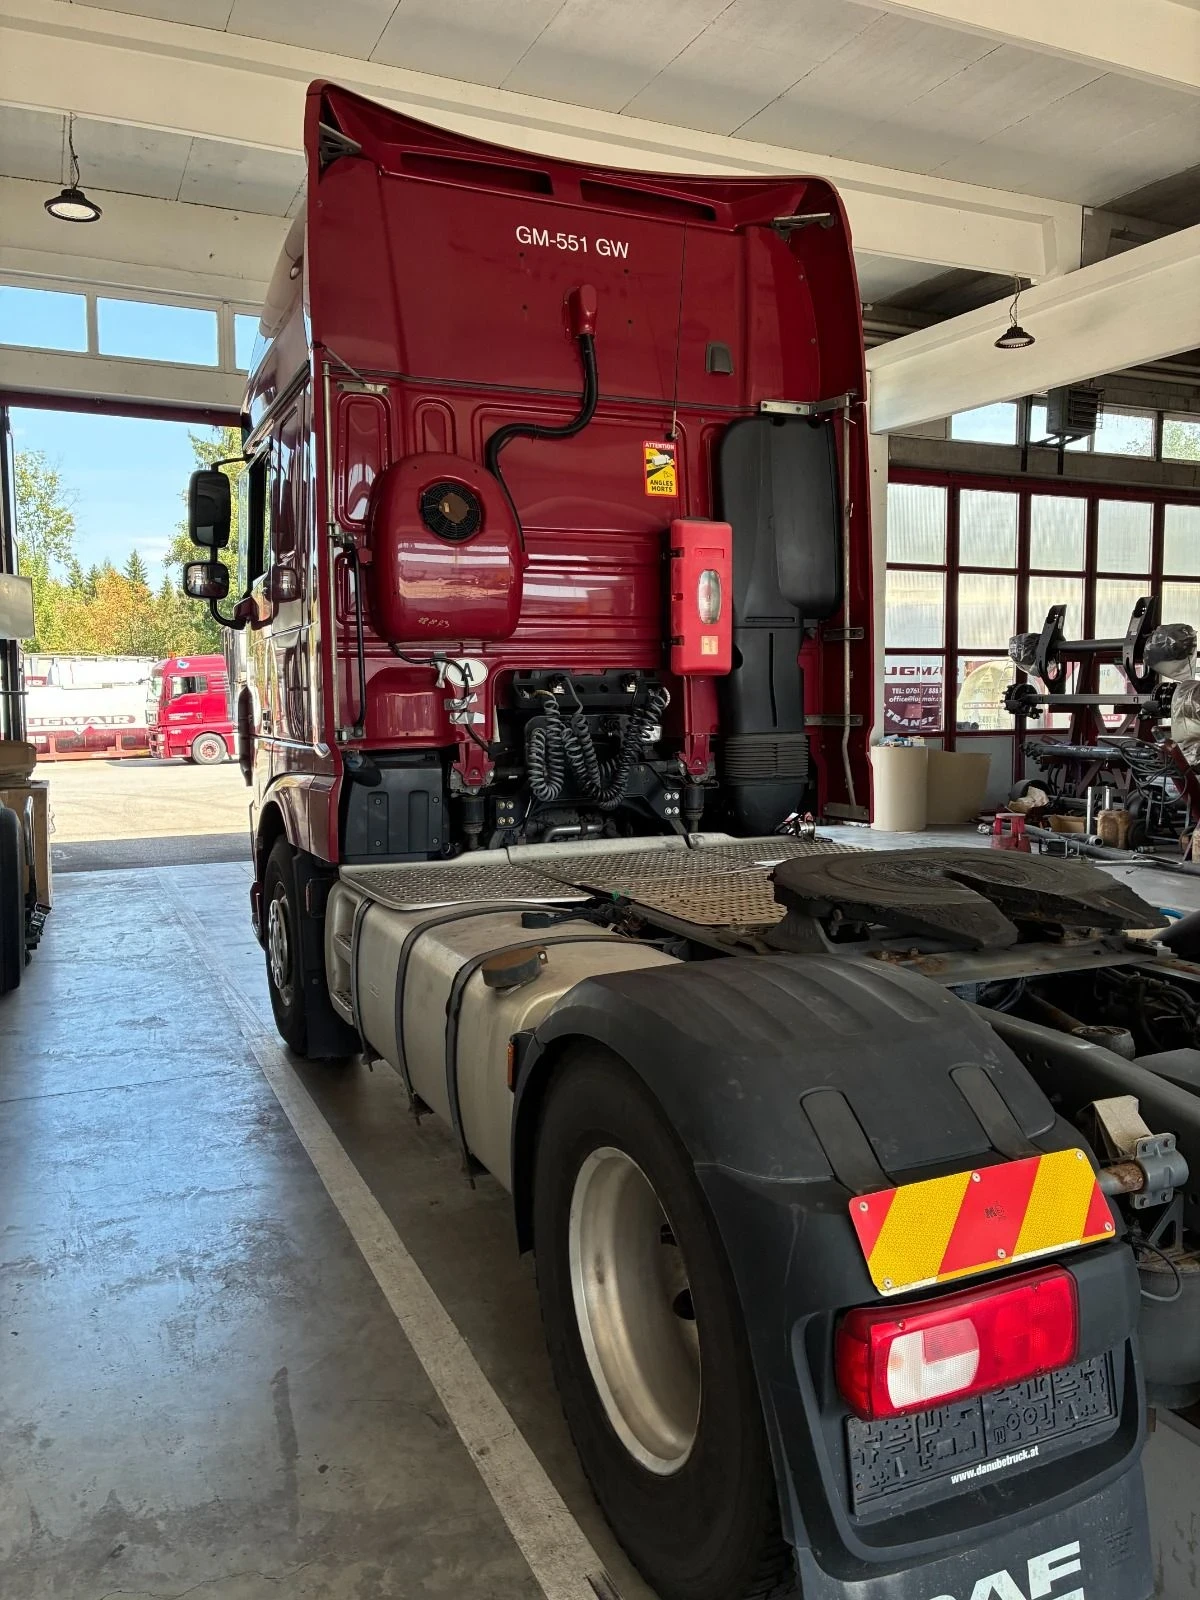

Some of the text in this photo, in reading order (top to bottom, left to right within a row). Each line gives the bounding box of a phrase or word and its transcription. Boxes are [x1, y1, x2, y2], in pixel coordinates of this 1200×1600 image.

[516, 225, 629, 259] GM-551 GW
[645, 442, 675, 450] ATTENTION
[460, 662, 474, 682] A
[950, 1445, 1040, 1485] www.danubetruck.at
[928, 1540, 1083, 1600] AF
